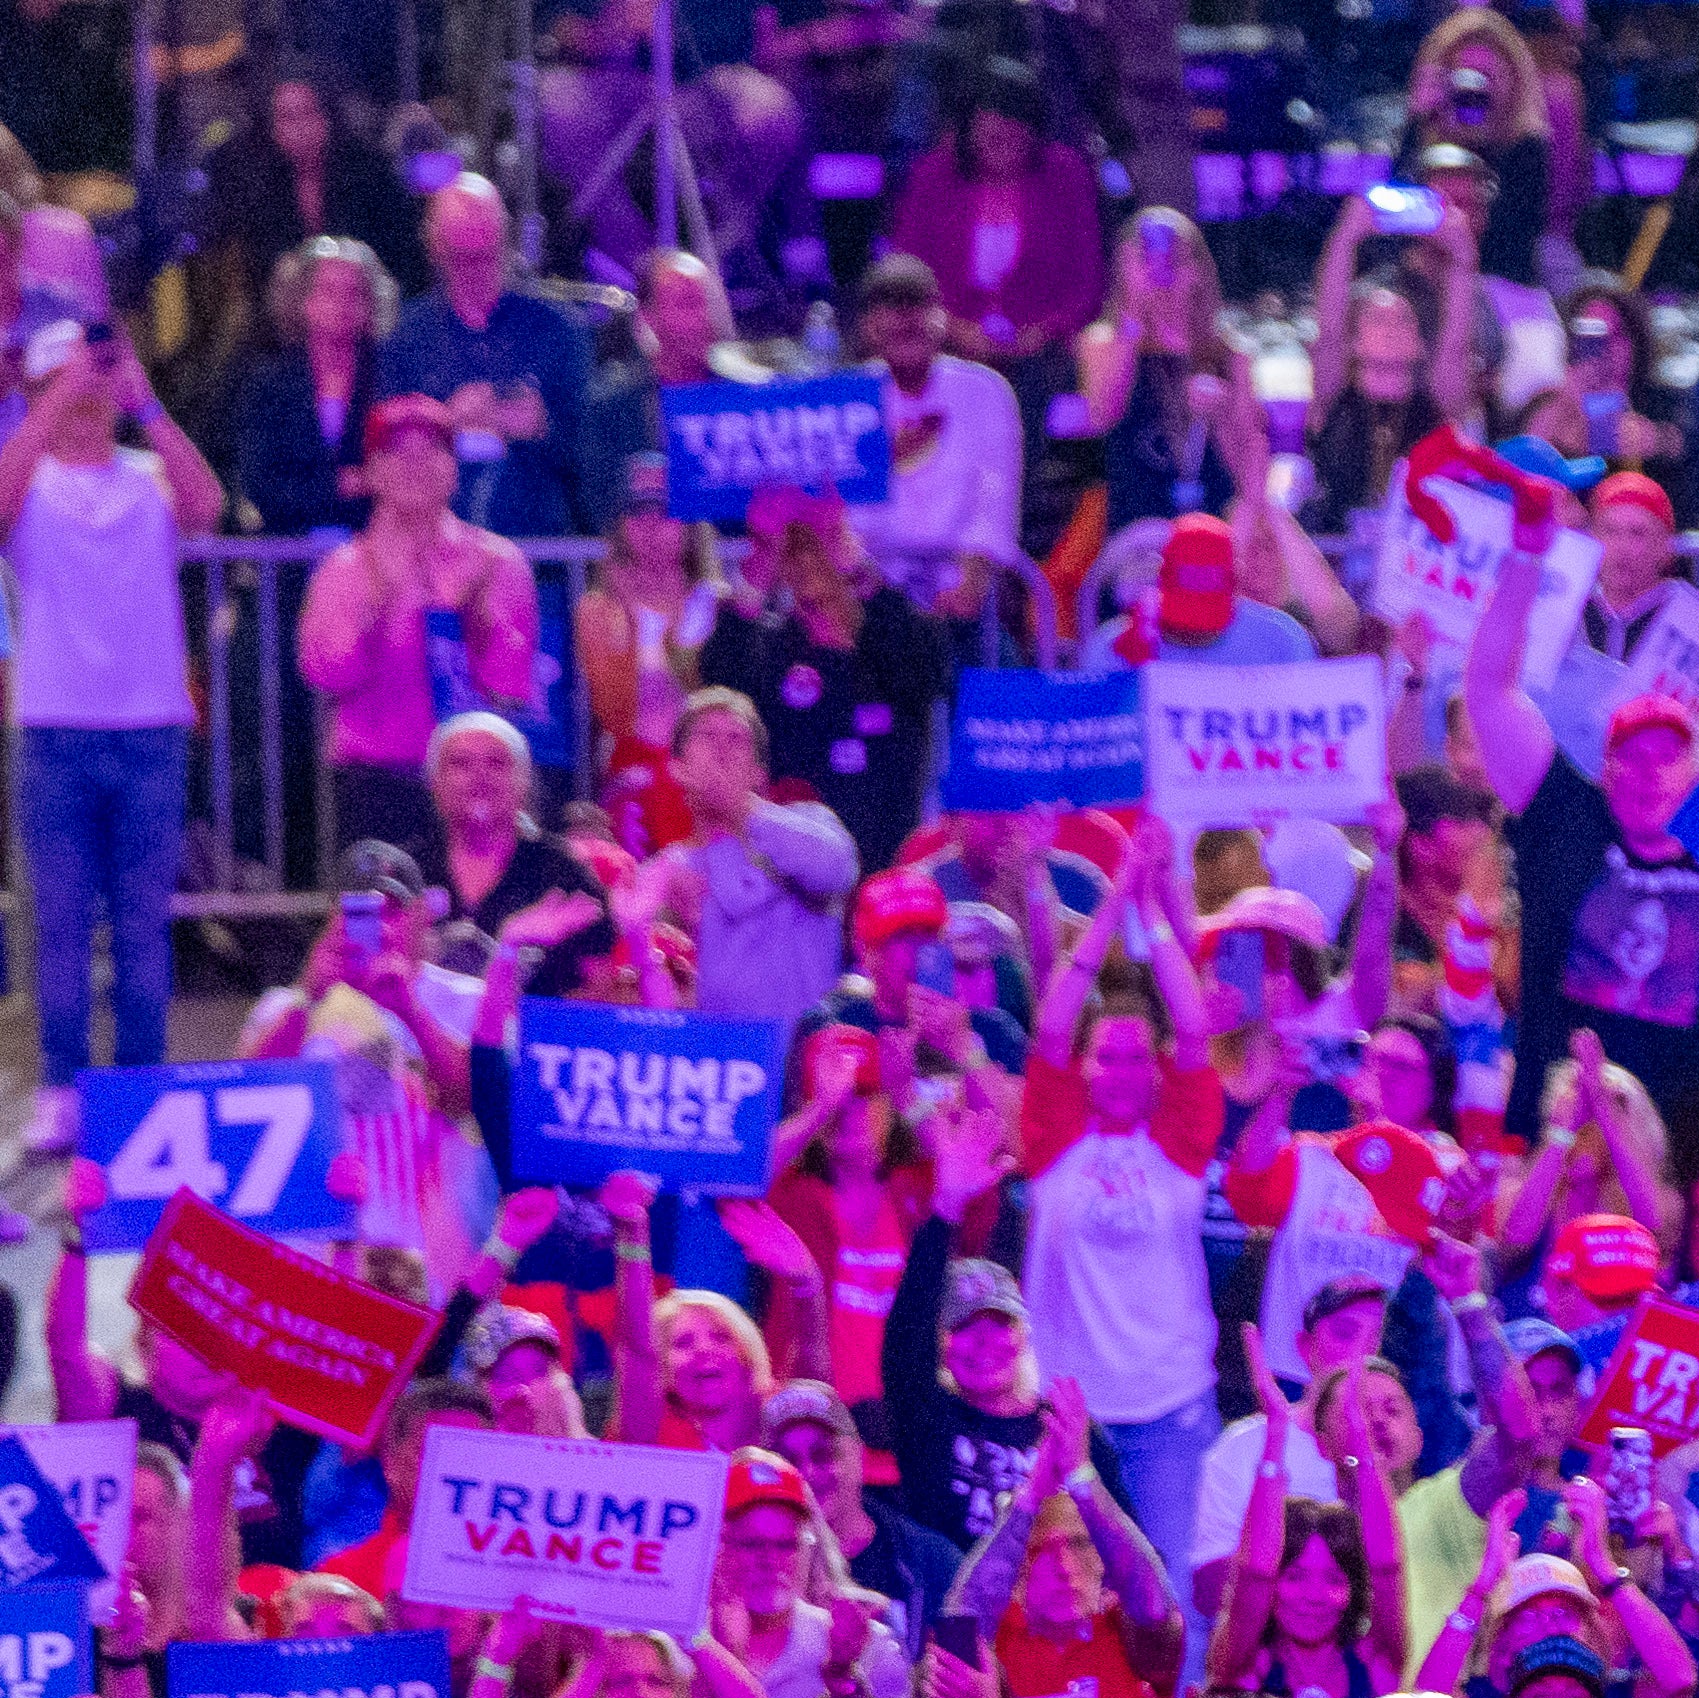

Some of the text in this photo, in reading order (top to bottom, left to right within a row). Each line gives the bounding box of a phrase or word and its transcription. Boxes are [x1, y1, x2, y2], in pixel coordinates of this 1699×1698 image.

[671, 405, 879, 457] TRUMP
[1164, 704, 1367, 741] TRUMP
[1185, 742, 1346, 773] VANCE
[527, 1043, 766, 1098] TRUMP
[555, 1091, 737, 1138] VANCE
[109, 1086, 311, 1215] 47
[262, 1302, 399, 1371] AMERICA
[443, 1477, 698, 1538] TRUMP
[465, 1522, 664, 1576] VANCE
